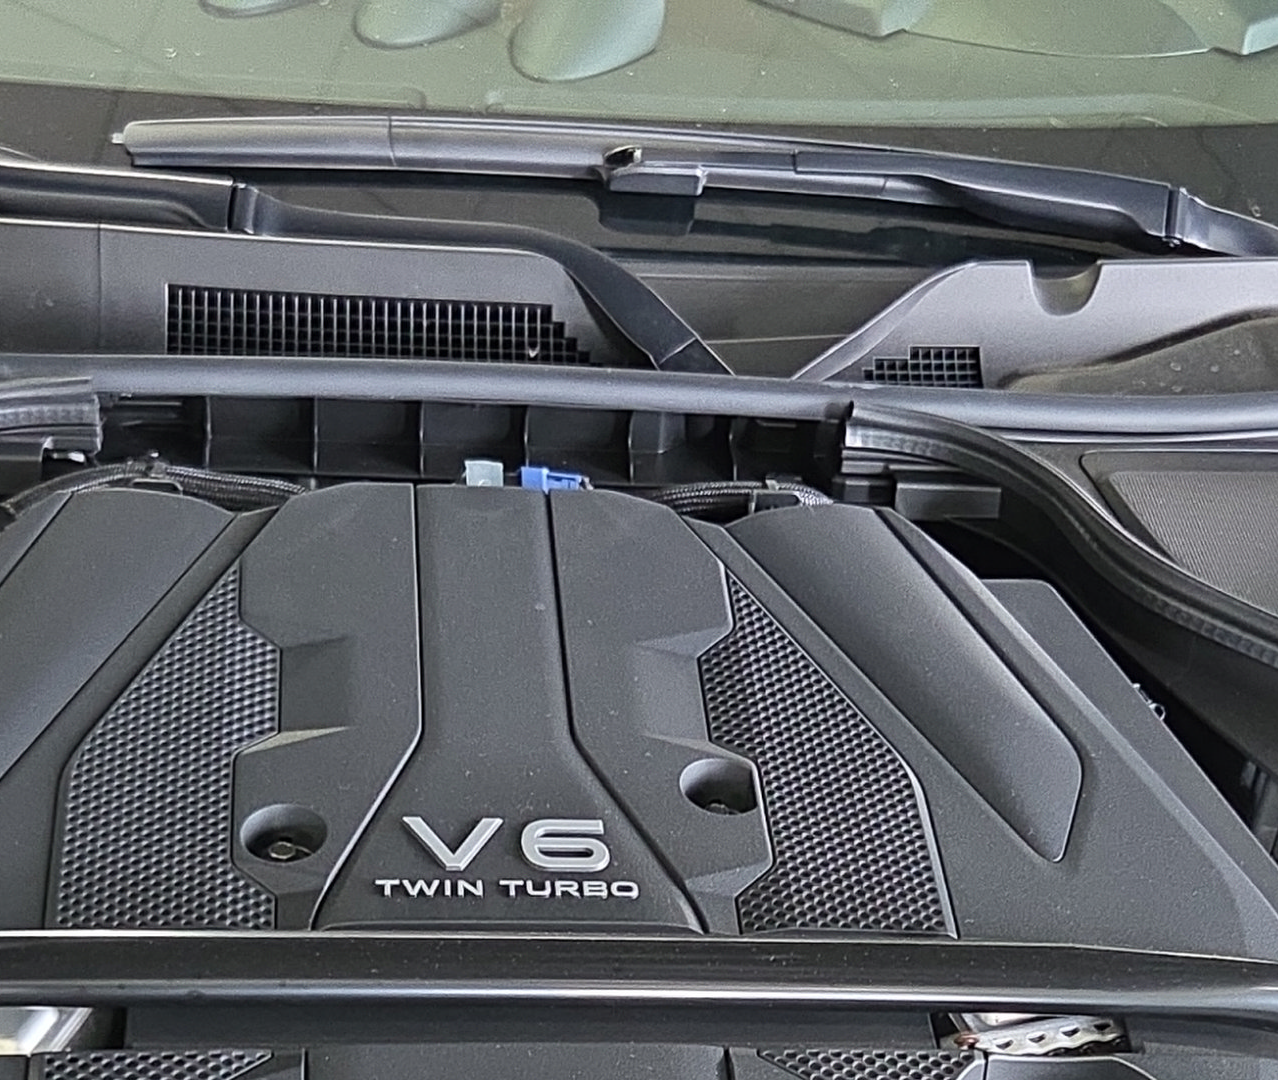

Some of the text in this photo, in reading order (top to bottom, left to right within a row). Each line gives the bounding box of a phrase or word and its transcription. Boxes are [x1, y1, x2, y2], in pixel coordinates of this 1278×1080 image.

[402, 816, 612, 872] V6
[375, 878, 640, 900] TWIN TURBO
